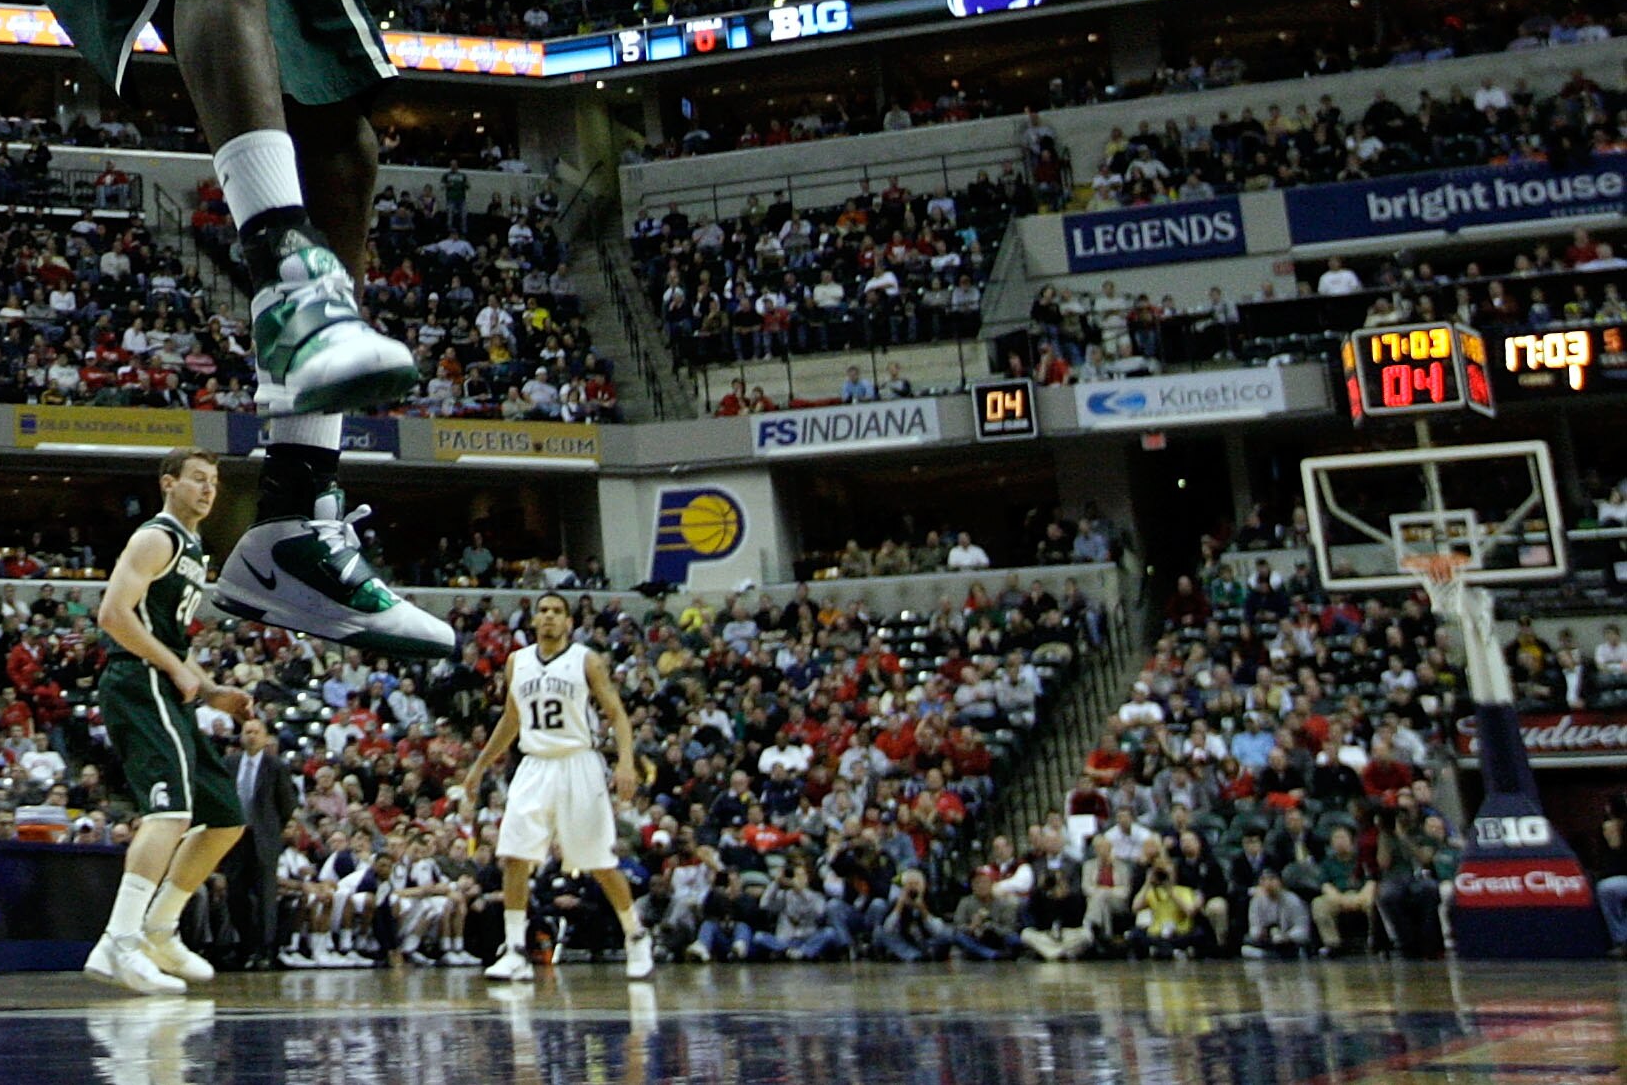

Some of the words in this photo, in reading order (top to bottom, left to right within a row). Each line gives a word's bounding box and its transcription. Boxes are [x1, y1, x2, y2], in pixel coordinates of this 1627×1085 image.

[694, 29, 716, 52] 0
[1367, 178, 1490, 224] bright
[1493, 170, 1624, 209] house
[1073, 210, 1238, 258] LEGENDS
[1372, 328, 1451, 364] 17:03
[1504, 330, 1591, 373] 17:03
[1158, 383, 1273, 407] Kinetico
[1382, 362, 1444, 408] 04
[985, 389, 1024, 422] 04
[438, 429, 597, 454] PACERS.COM
[758, 419, 798, 447] FS
[801, 408, 928, 445] INDIANA
[176, 584, 202, 626] 20
[529, 699, 563, 730] 12
[1454, 872, 1523, 896] Great
[1524, 870, 1581, 899] Clips
